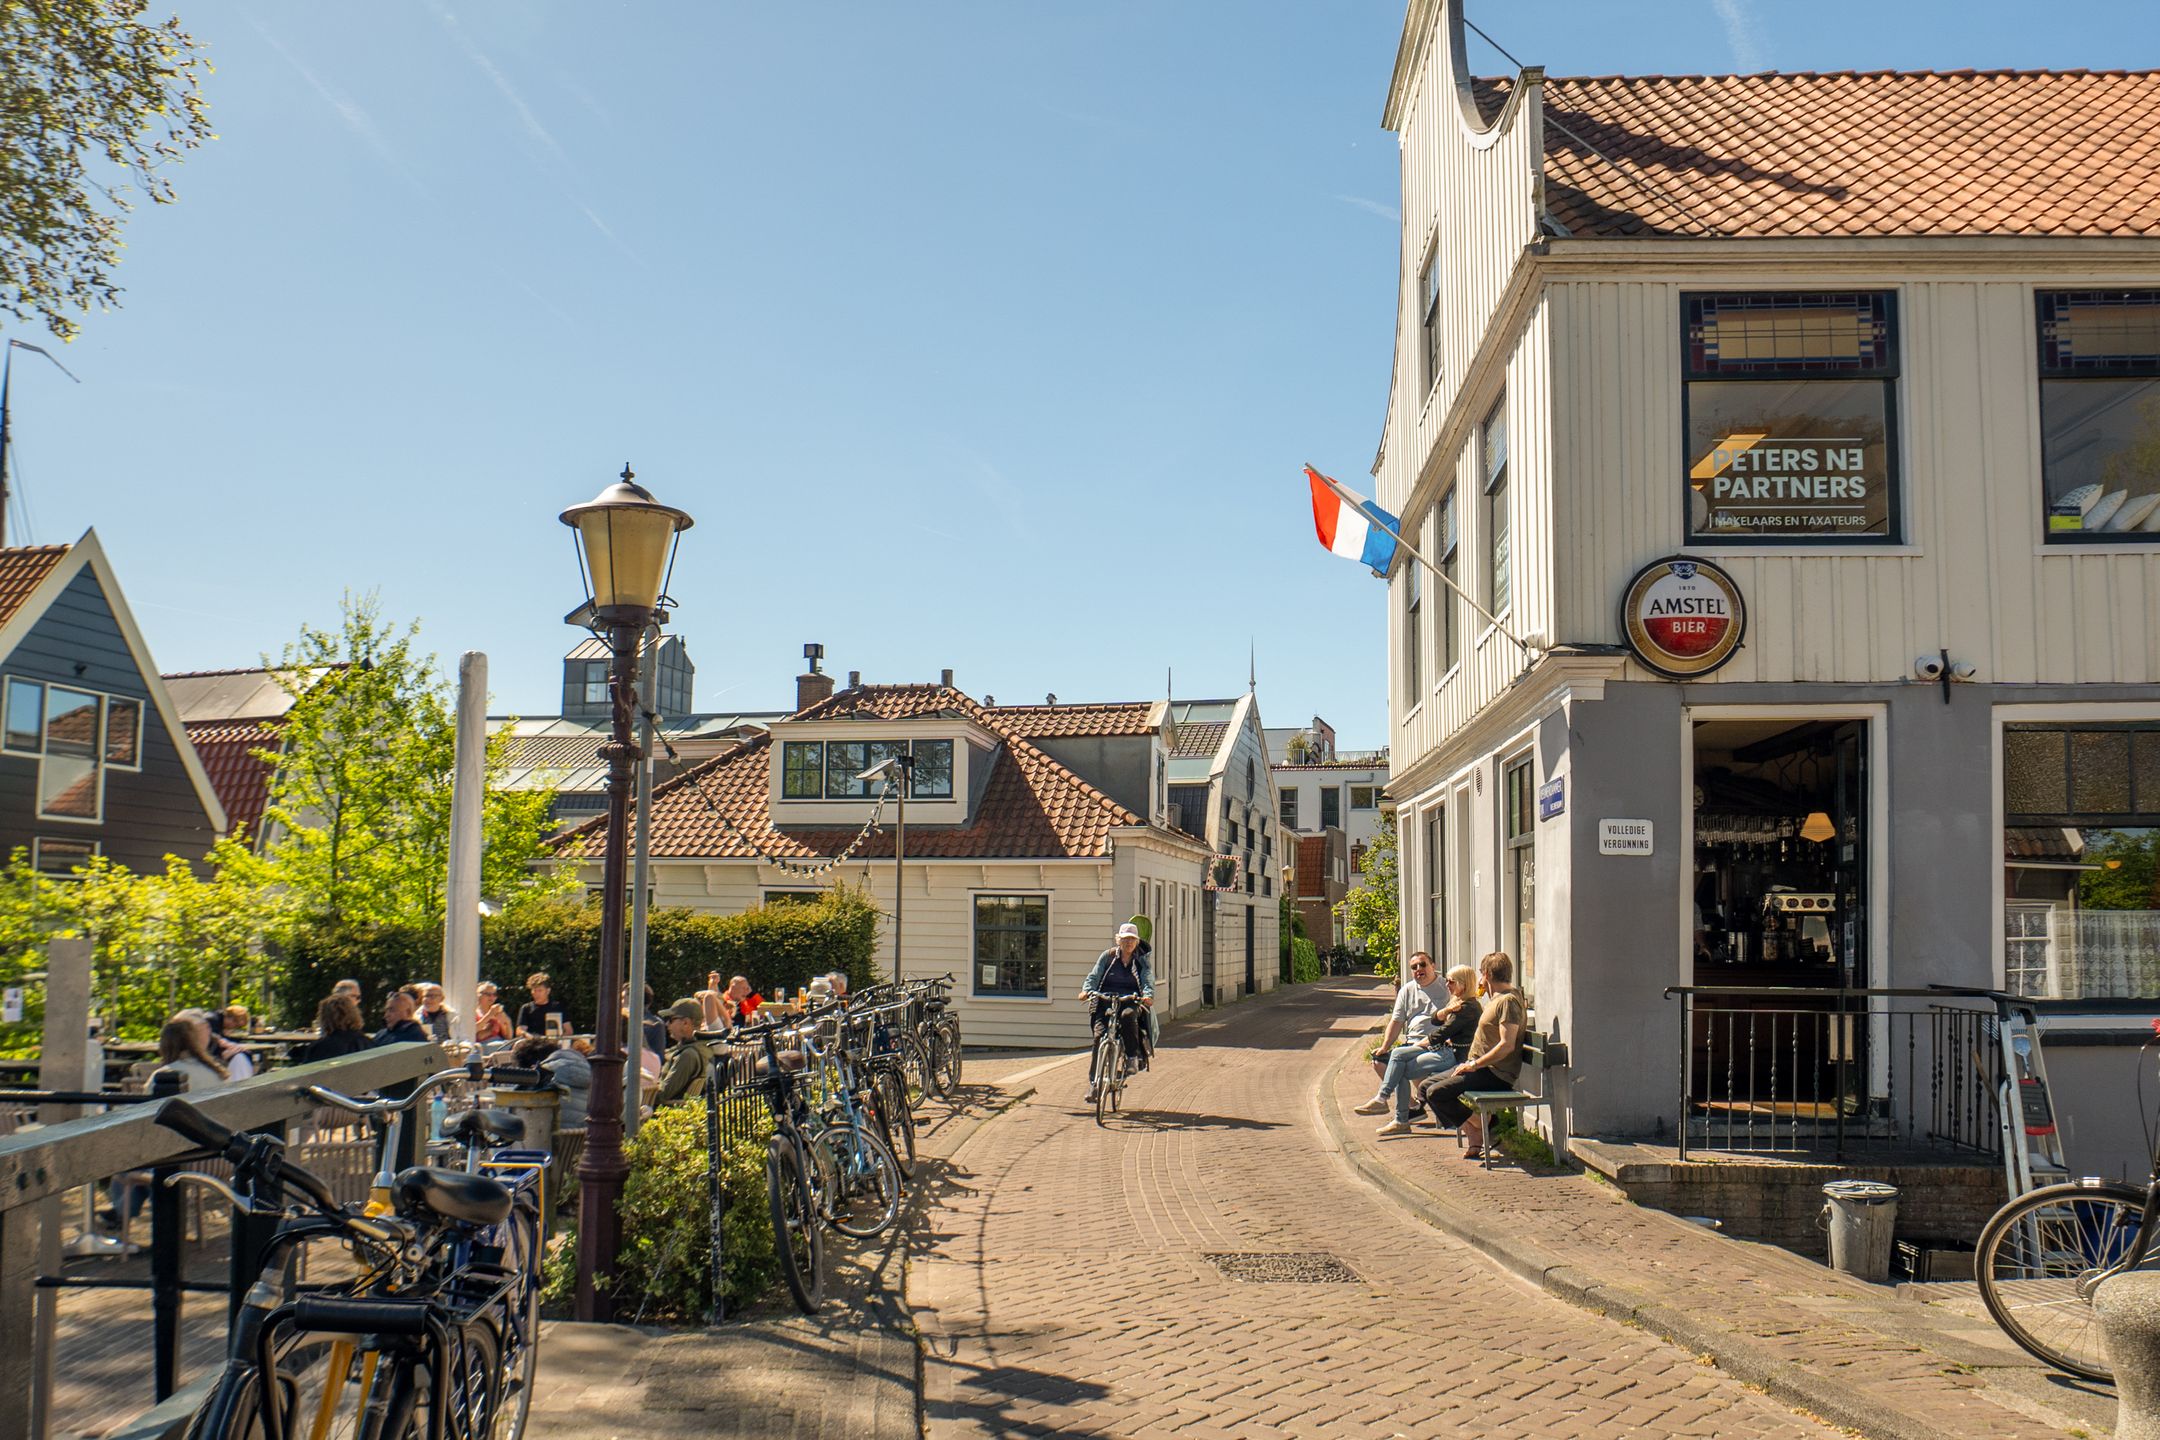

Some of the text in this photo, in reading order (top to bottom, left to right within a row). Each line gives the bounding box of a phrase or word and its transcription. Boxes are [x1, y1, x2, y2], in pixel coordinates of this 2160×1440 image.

[1713, 448, 1818, 472] PETERS
[1714, 476, 1867, 499] PARTNERS
[1715, 515, 1866, 526] MAKELAARS EN TAXATEURS
[1650, 598, 1725, 615] AMSTEL
[1672, 621, 1706, 633] BIER
[1607, 825, 1646, 835] VOLLEDIGE
[1603, 839, 1649, 849] VERGUNNING
